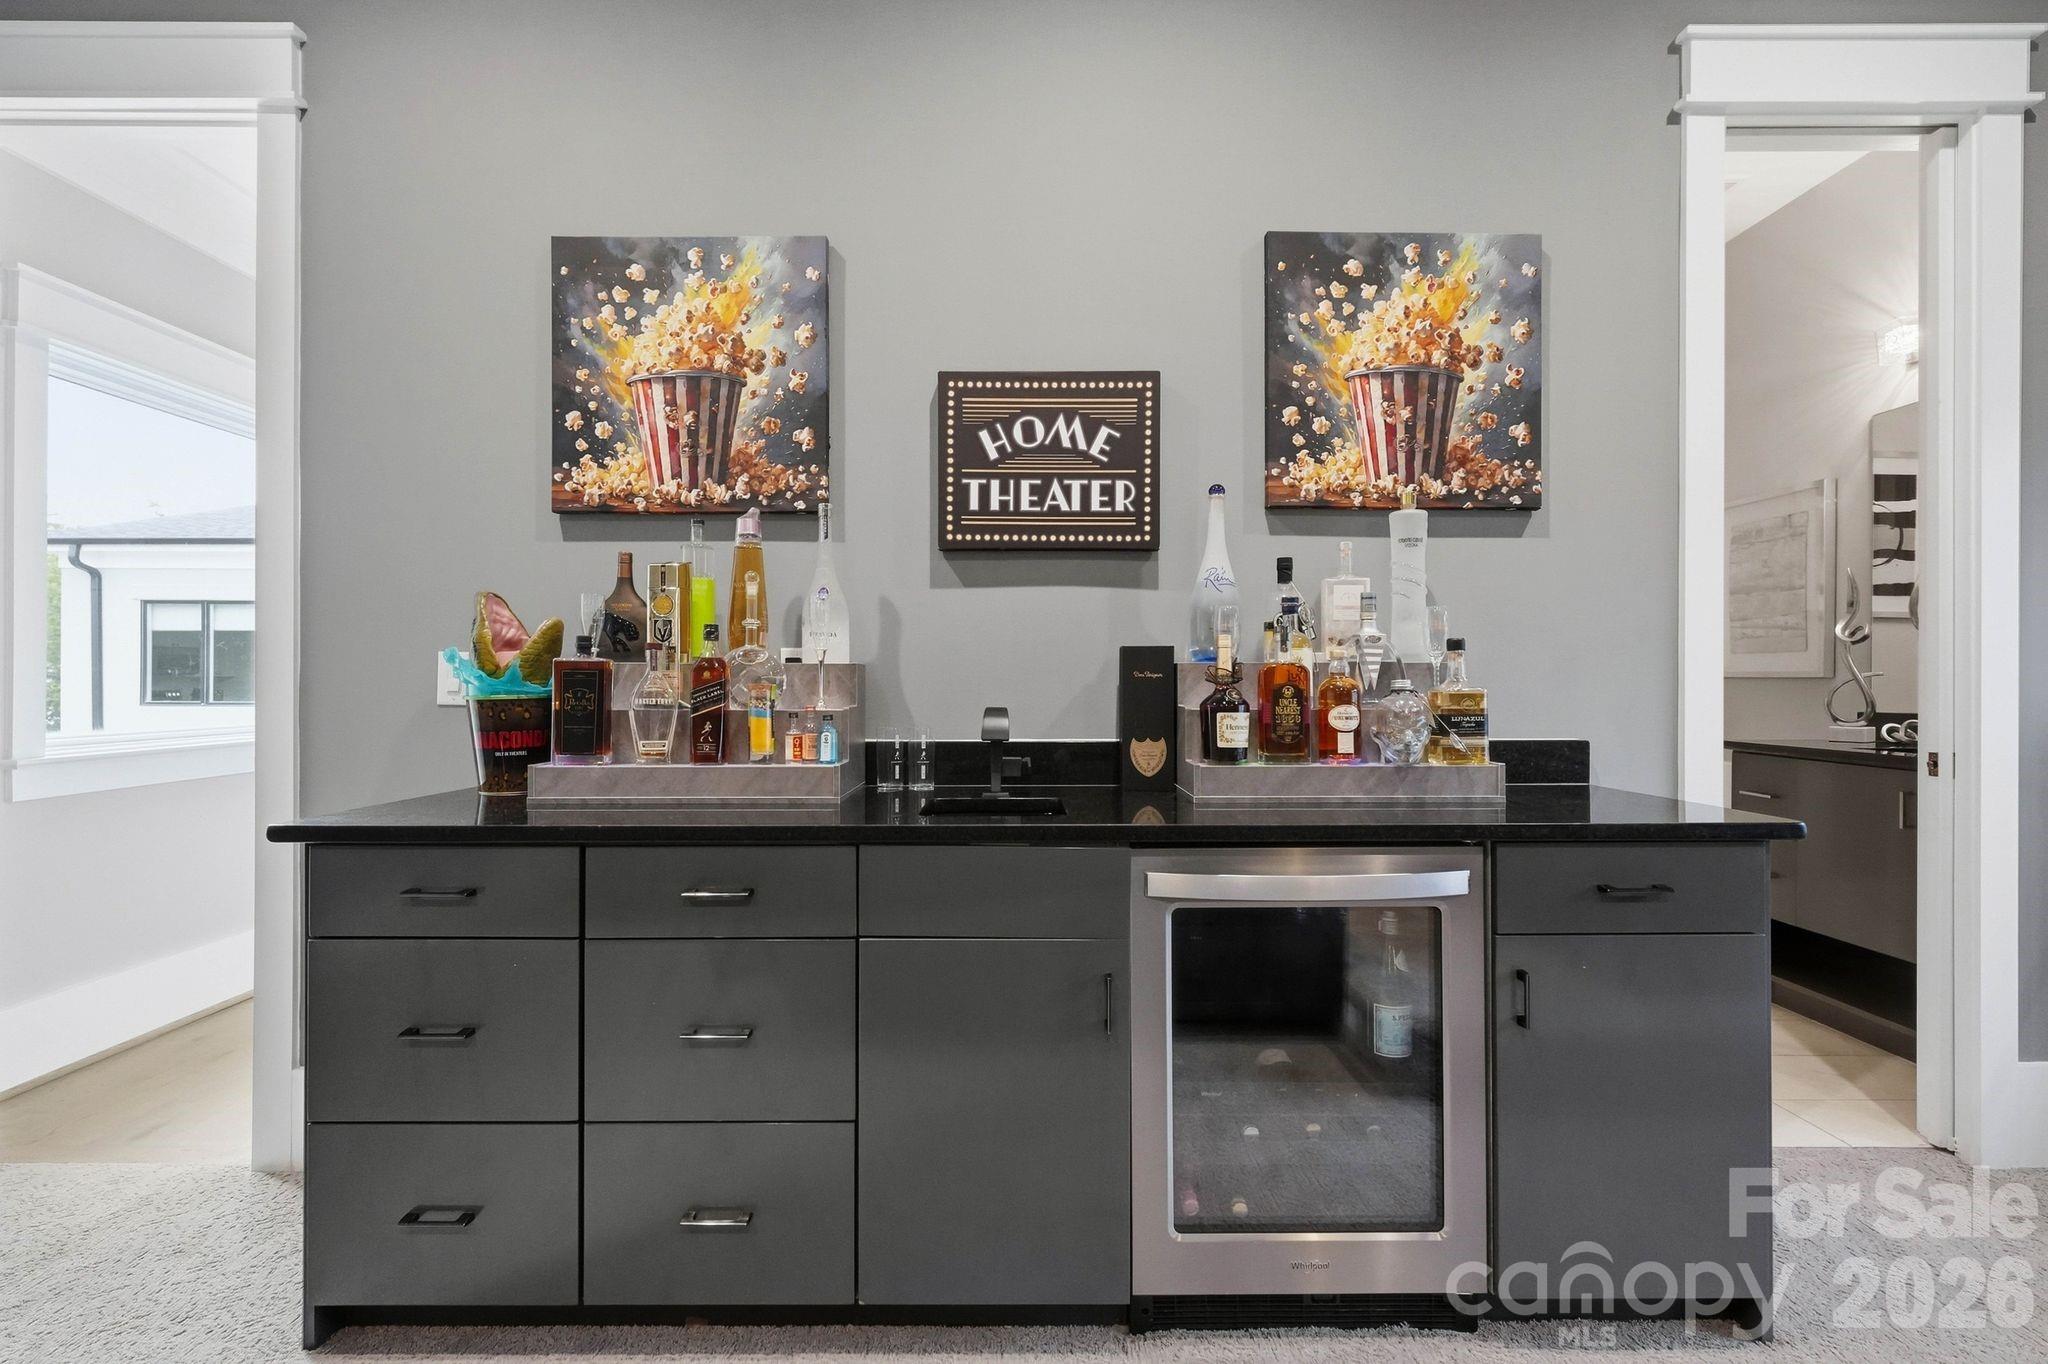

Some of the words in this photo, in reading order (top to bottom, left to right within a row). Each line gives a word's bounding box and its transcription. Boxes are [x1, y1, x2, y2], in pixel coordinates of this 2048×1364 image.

[978, 412, 1121, 462] HOME
[961, 477, 1136, 512] THEATER
[1279, 698, 1298, 706] UNCLE
[1275, 706, 1301, 714] NEAREST
[703, 743, 710, 751] 12
[1290, 1261, 1330, 1272] Whirlpool
